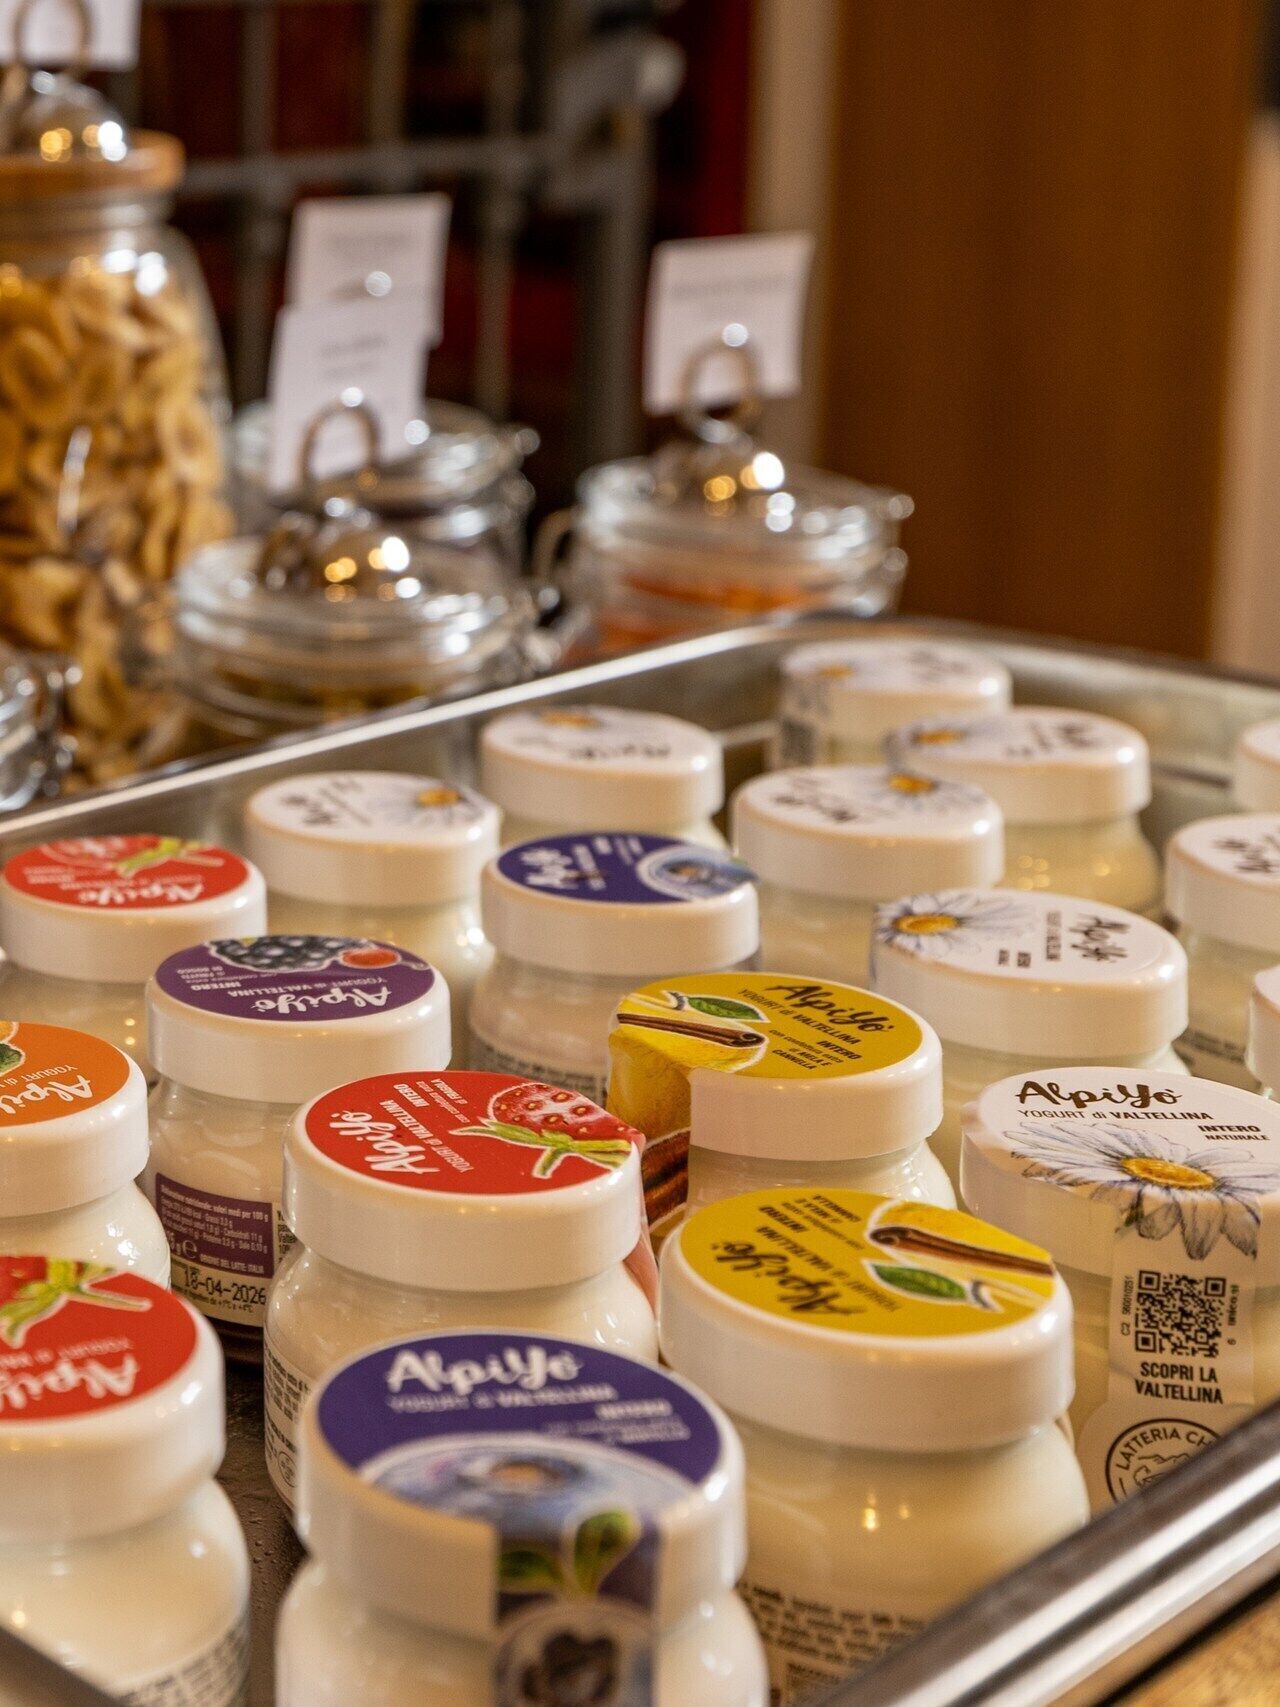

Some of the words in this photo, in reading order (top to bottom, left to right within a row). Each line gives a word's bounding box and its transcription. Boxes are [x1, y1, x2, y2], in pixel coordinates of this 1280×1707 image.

[190, 981, 241, 991] INTERO
[227, 984, 313, 998] VALTELLINA
[736, 988, 781, 1011] YOGURT
[779, 1007, 793, 1016] di
[791, 1012, 861, 1046] VALTELLINA
[816, 1040, 863, 1060] INTERO
[5, 1076, 19, 1087] di
[20, 1063, 78, 1083] YOGURT
[393, 1083, 431, 1107] INTERO
[378, 1099, 434, 1139] VALTELLINA
[1018, 1109, 1085, 1120] YOGURT
[1092, 1111, 1106, 1119] di
[1110, 1110, 1214, 1120] VALTELLINA
[1197, 1124, 1261, 1133] INTERO
[431, 1146, 475, 1173] YOGURT
[758, 1206, 809, 1234] INTERO
[756, 1226, 833, 1272] VALTELLINA
[184, 1265, 267, 1305] 18-04-2026
[1140, 1361, 1194, 1381] SCOPRI
[1200, 1366, 1218, 1383] LA
[1134, 1379, 1224, 1405] VALTELLINA
[1115, 1427, 1182, 1471] LATTERIA
[1186, 1430, 1213, 1448] CH
